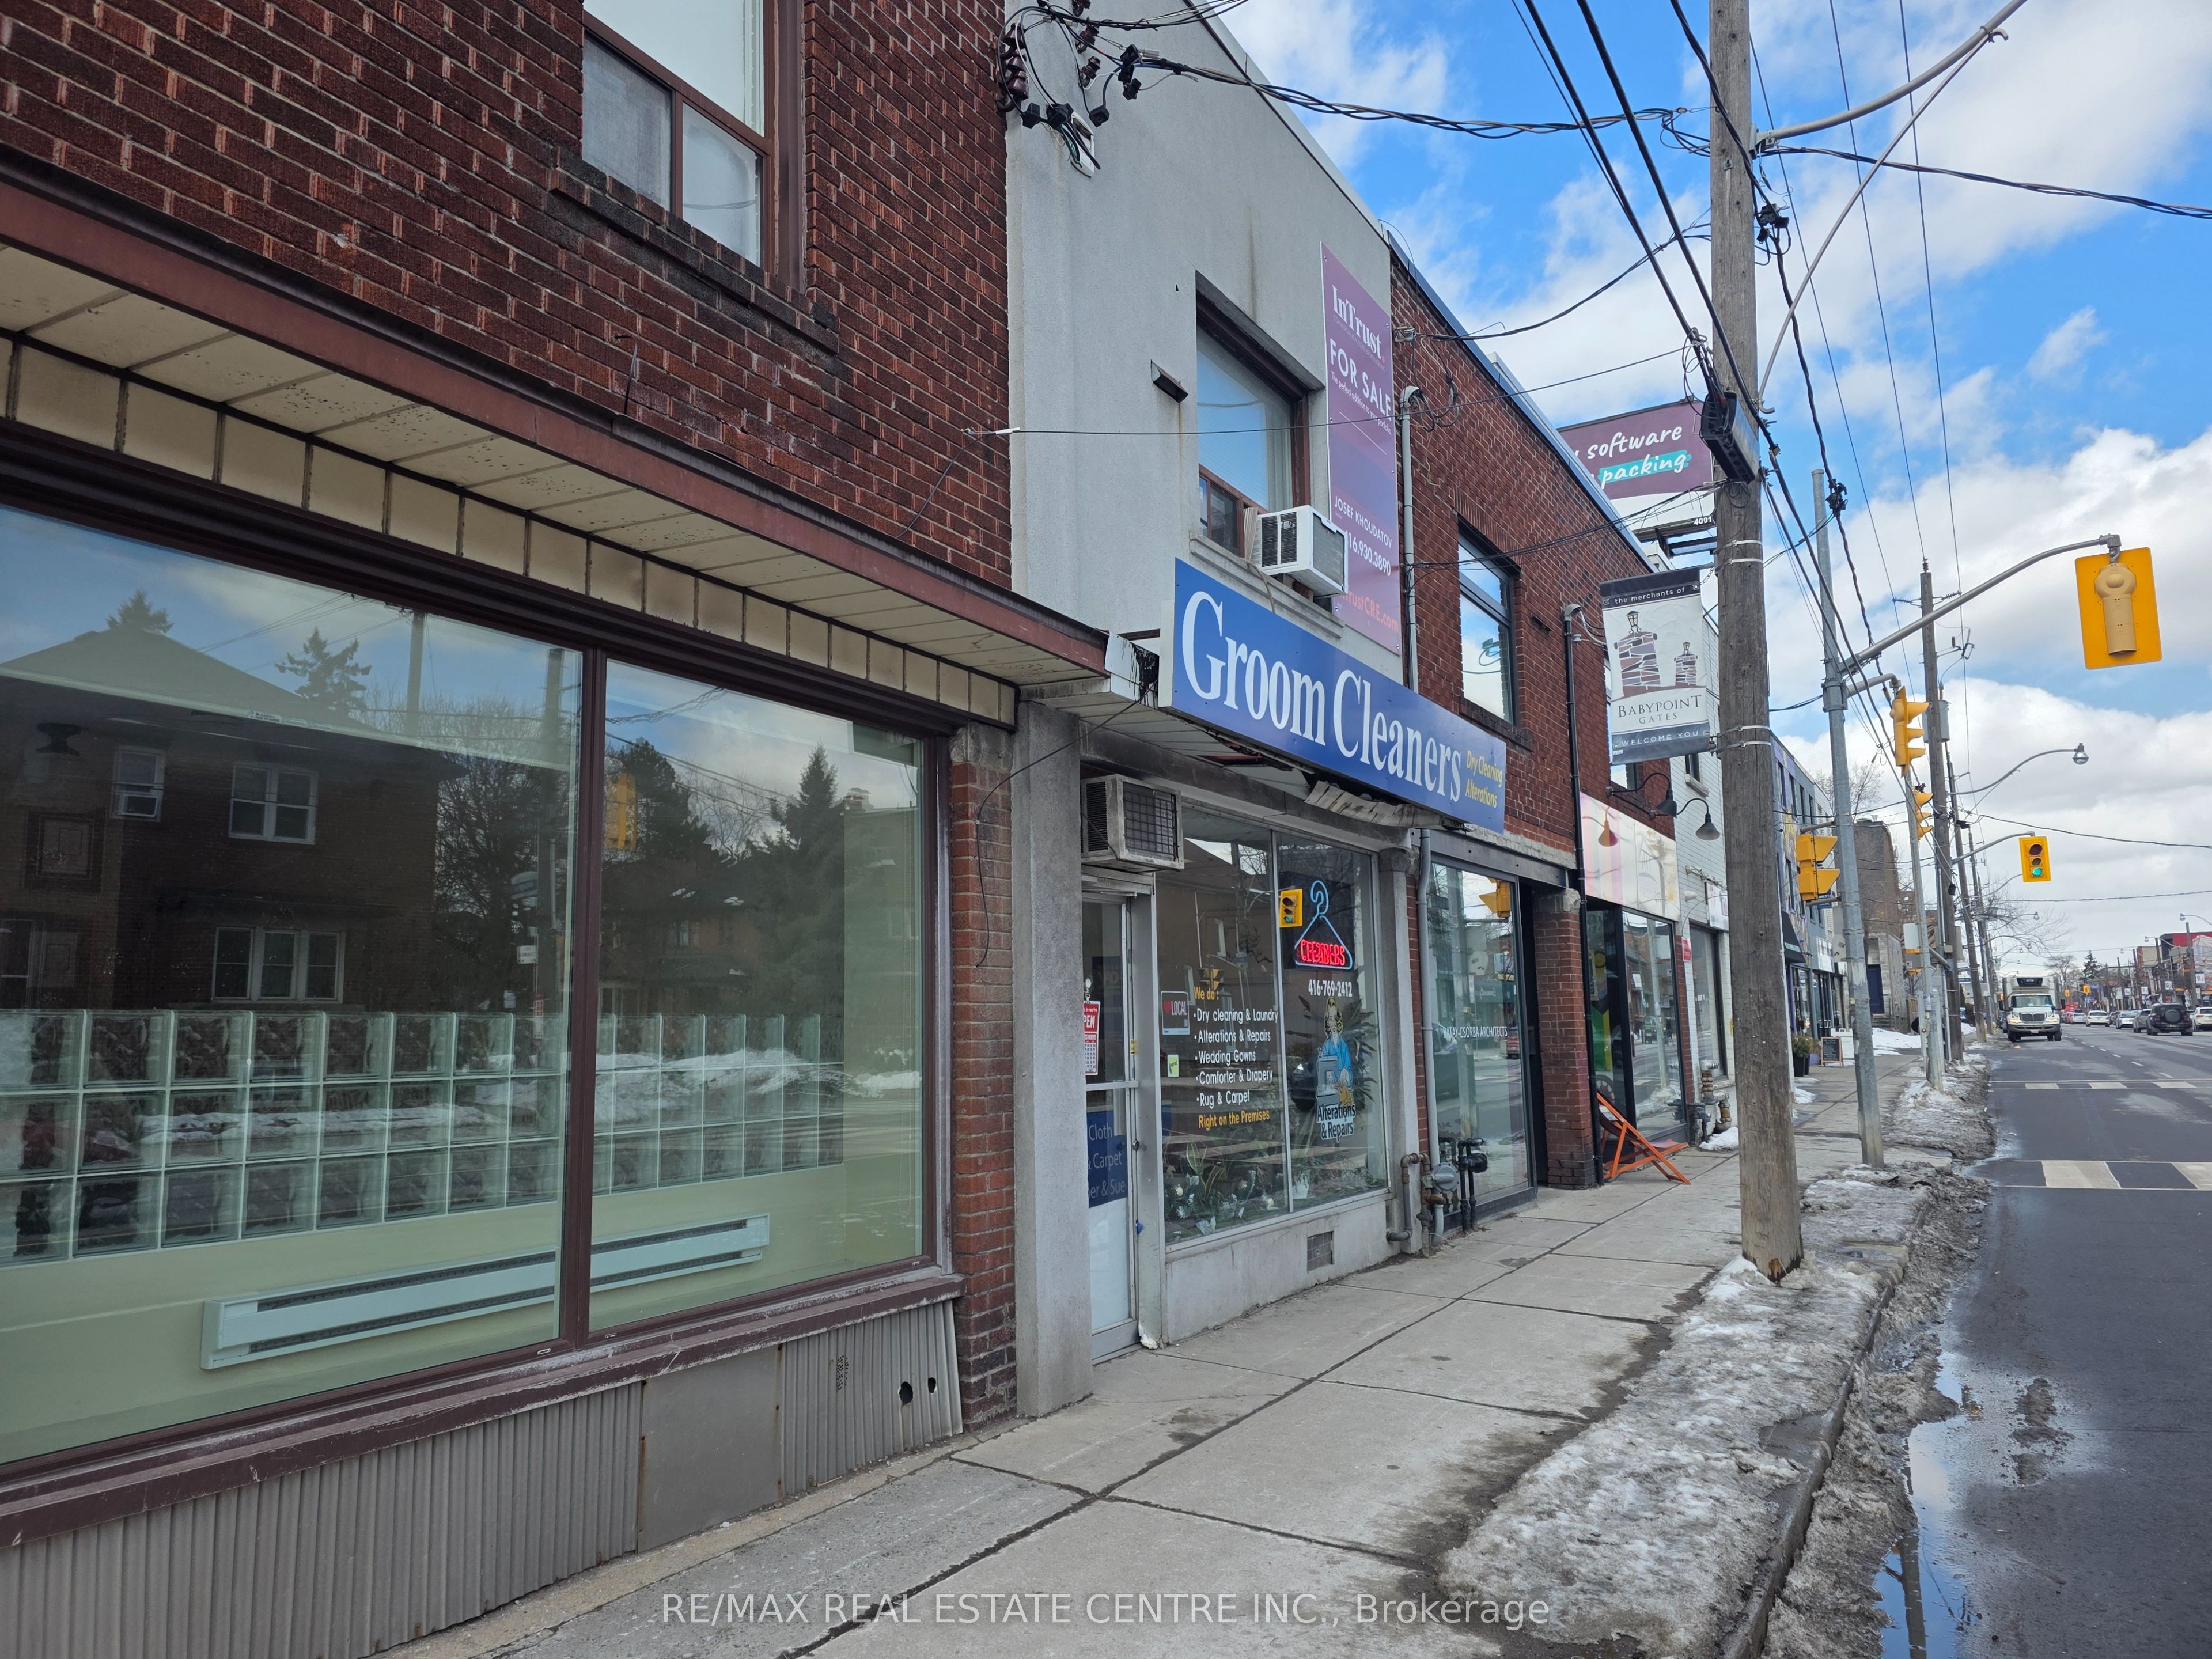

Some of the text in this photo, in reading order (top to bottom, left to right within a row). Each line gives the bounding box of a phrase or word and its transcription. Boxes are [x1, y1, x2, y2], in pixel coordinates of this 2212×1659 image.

[1330, 338, 1358, 389] FOR
[1362, 372, 1392, 422] SALE
[1587, 426, 1683, 459] software
[1601, 453, 1687, 490] packing
[1335, 495, 1392, 548] JOSEF KHOUDATOV
[1694, 516, 1712, 525] 4001
[1347, 531, 1391, 576] 16.930.3890
[1631, 589, 1673, 601] merchants
[1182, 591, 1462, 802] Groom Cleaners
[1618, 695, 1702, 718] BABYPOINT
[1639, 713, 1677, 724] GATES
[1622, 734, 1672, 746] WELCOME
[1467, 750, 1503, 788] Dry Cleaning
[1465, 779, 1497, 808] Alterations
[1194, 986, 1205, 1000] We
[1171, 1001, 1188, 1016] LOCAL
[1196, 1008, 1278, 1024] Dry cleaning & Laundry
[1084, 1015, 1096, 1028] PEN
[1198, 1029, 1271, 1044] Alterations & Repairs
[1480, 1026, 1508, 1037] ARCHITECTS
[1199, 1049, 1256, 1066] Wedding Gowns
[1199, 1069, 1273, 1085] Comforter & Drapery
[1200, 1089, 1250, 1109] Rug & Carpet
[1198, 1108, 1270, 1131] Right on the Premises
[1318, 1104, 1356, 1122] Alterations
[1089, 1123, 1113, 1141] Cloth
[1321, 1122, 1354, 1142] & Repairs
[1093, 1151, 1122, 1171] Carpet
[1101, 1180, 1108, 1196] &
